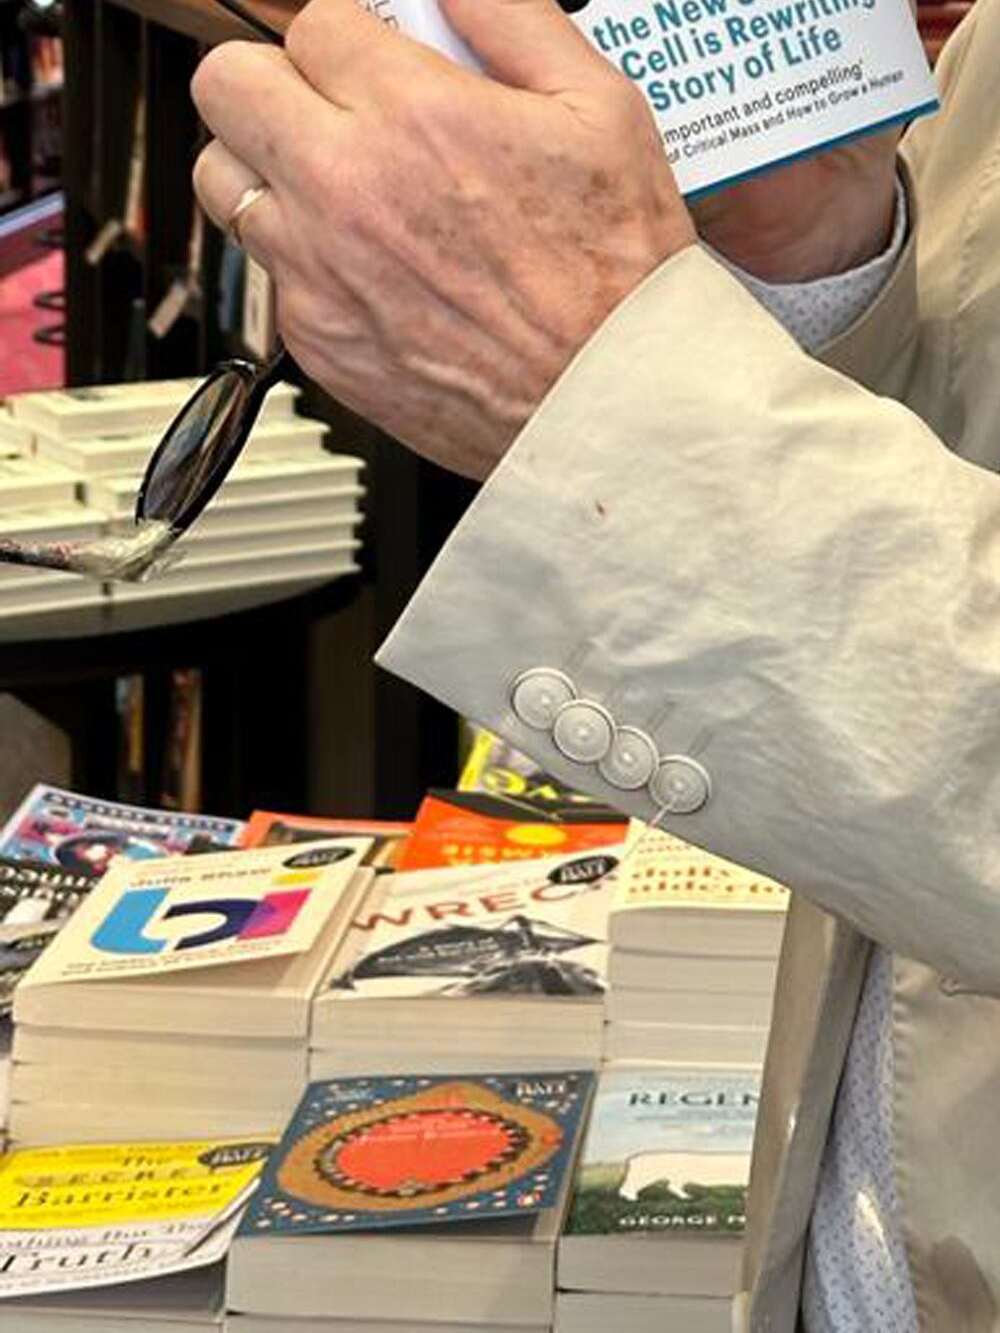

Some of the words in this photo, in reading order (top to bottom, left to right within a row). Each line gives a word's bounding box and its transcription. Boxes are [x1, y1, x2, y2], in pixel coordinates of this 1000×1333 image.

[592, 13, 650, 52] the
[620, 32, 689, 81] Cell
[689, 28, 722, 59] is
[648, 62, 738, 112] Story
[743, 45, 777, 79] of
[781, 23, 843, 66] Life
[682, 129, 730, 159] Critical
[729, 121, 762, 143] Mass
[762, 111, 786, 131] and
[785, 102, 813, 121] How
[828, 87, 860, 106] Grow
[743, 90, 773, 118] and
[12, 1182, 231, 1208] Barrister
[618, 1216, 717, 1227] GEORGE
